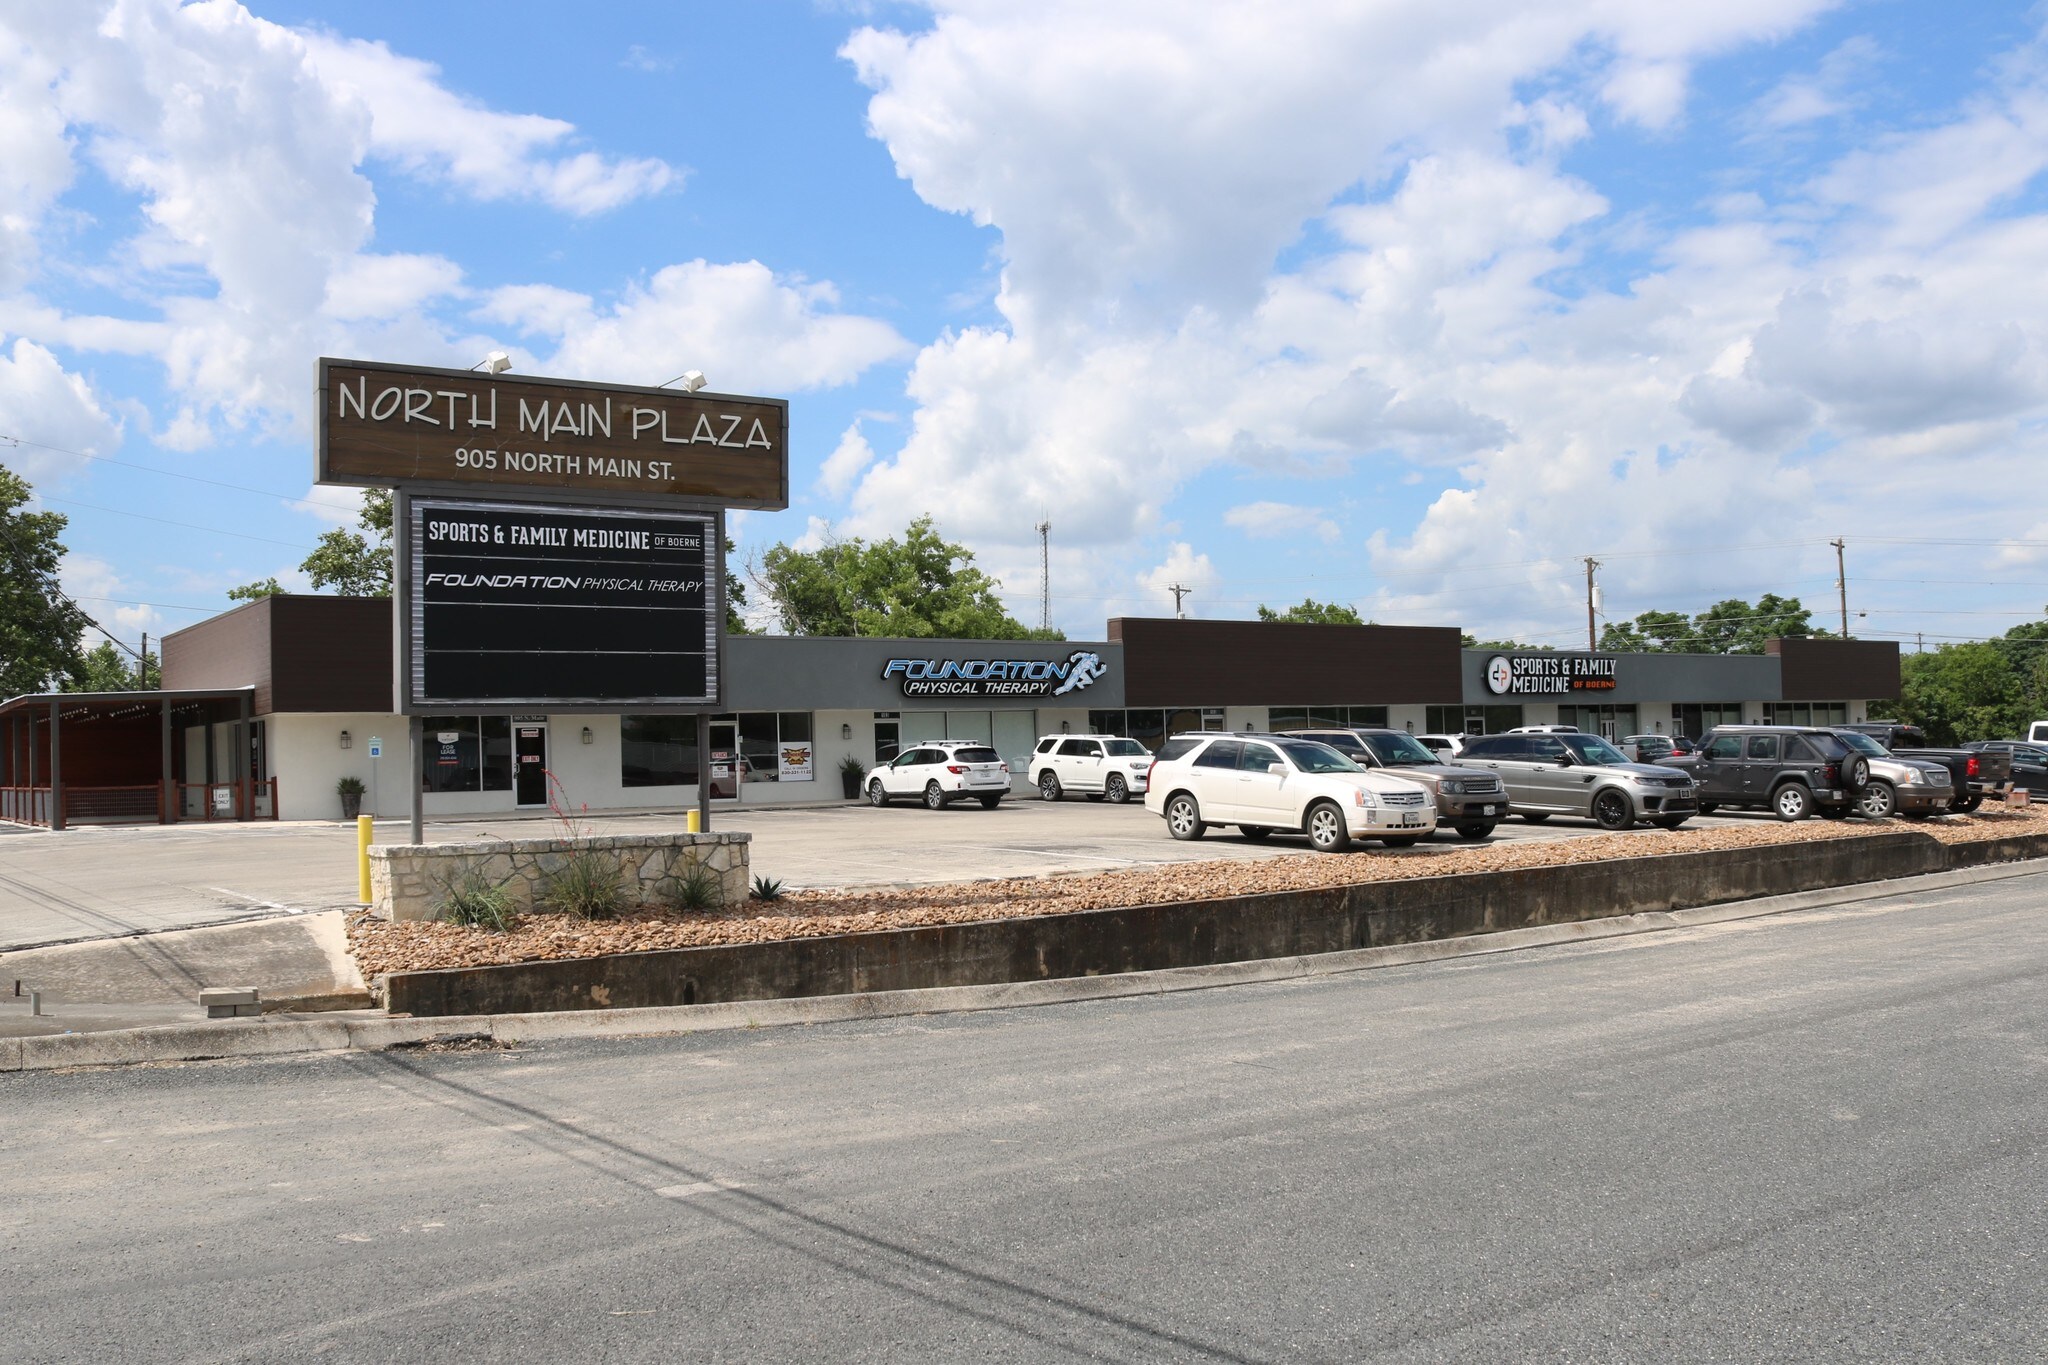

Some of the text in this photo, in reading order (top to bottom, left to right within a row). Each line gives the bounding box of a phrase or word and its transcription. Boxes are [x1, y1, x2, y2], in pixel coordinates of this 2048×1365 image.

[340, 376, 772, 450] NORTH MAIN PLAZA
[455, 448, 676, 481] 905 NORTH MAIN ST.
[429, 521, 700, 550] SPORTS & FAMILY MEDICINE OF BOERNE
[425, 573, 703, 593] FOUNDATION PHYSICAL THERAPY
[883, 659, 1070, 680] FOUNDATION
[1513, 658, 1617, 675] SPORTS & FAMILY
[908, 681, 1050, 695] PHYSICAL THERAPY
[1512, 676, 1616, 693] MEDICINE OF BOERNE
